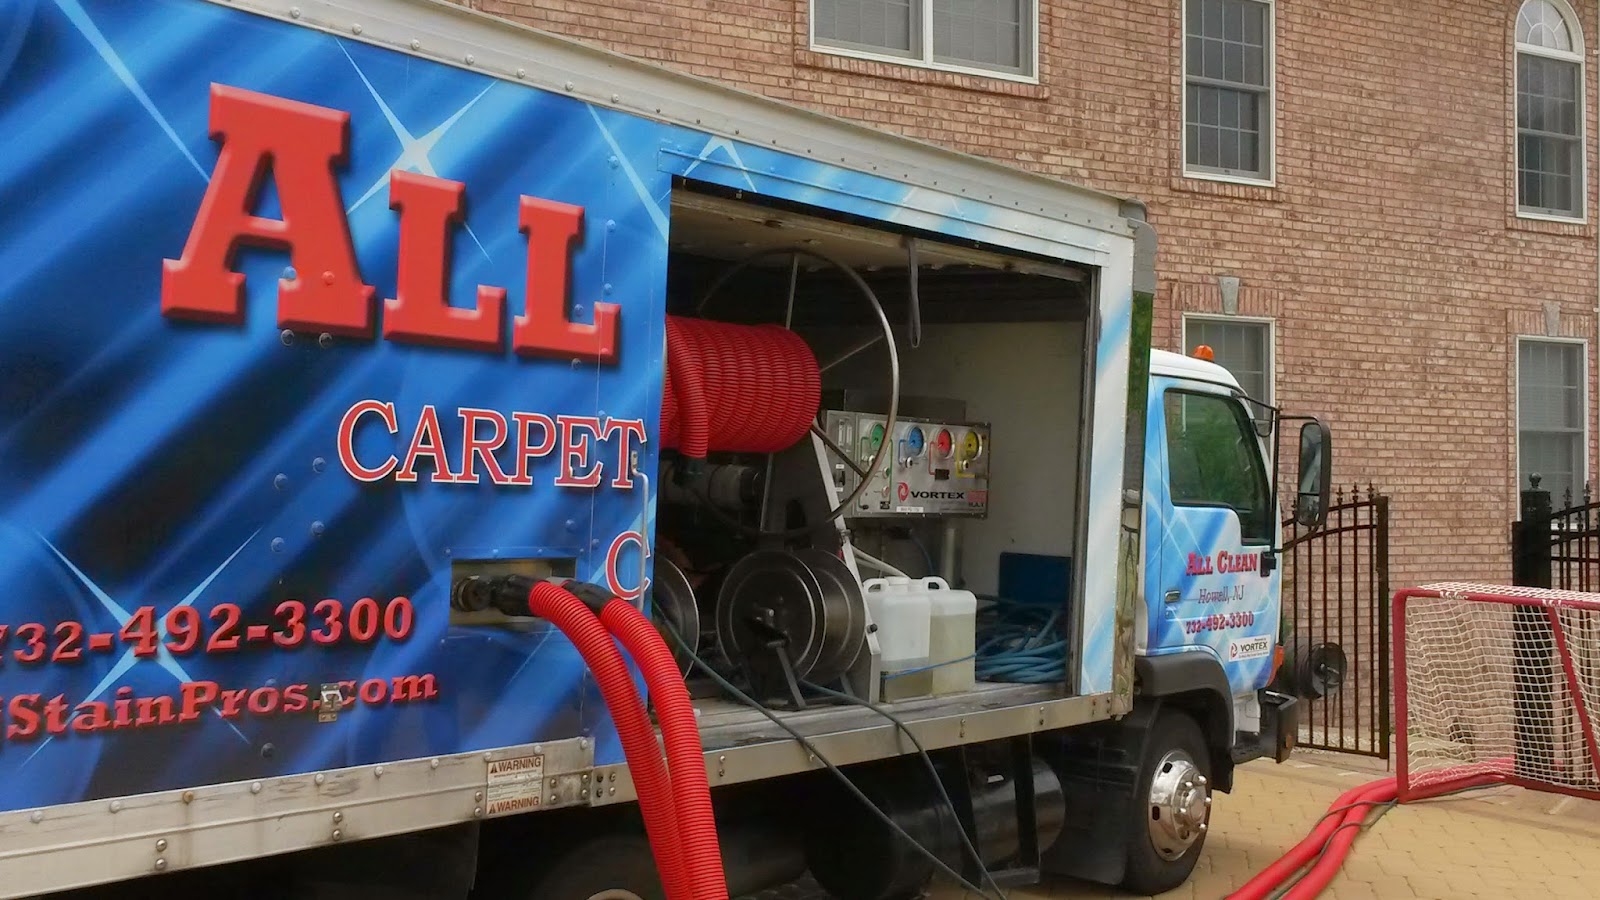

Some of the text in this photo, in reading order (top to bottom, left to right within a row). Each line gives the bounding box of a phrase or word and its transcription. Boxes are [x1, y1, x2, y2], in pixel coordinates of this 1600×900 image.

[161, 82, 621, 364] ALL
[337, 399, 647, 488] CARPET
[911, 491, 964, 499] VORTEX
[1186, 551, 1257, 576] ALL CLEAN
[1198, 585, 1245, 604] Howell, NJ
[1186, 611, 1254, 634] 732-492-3300
[1240, 642, 1268, 652] VORTEX
[0, 673, 438, 739] StainPros.com
[499, 757, 541, 772] WARNING
[497, 796, 539, 812] WARNING
